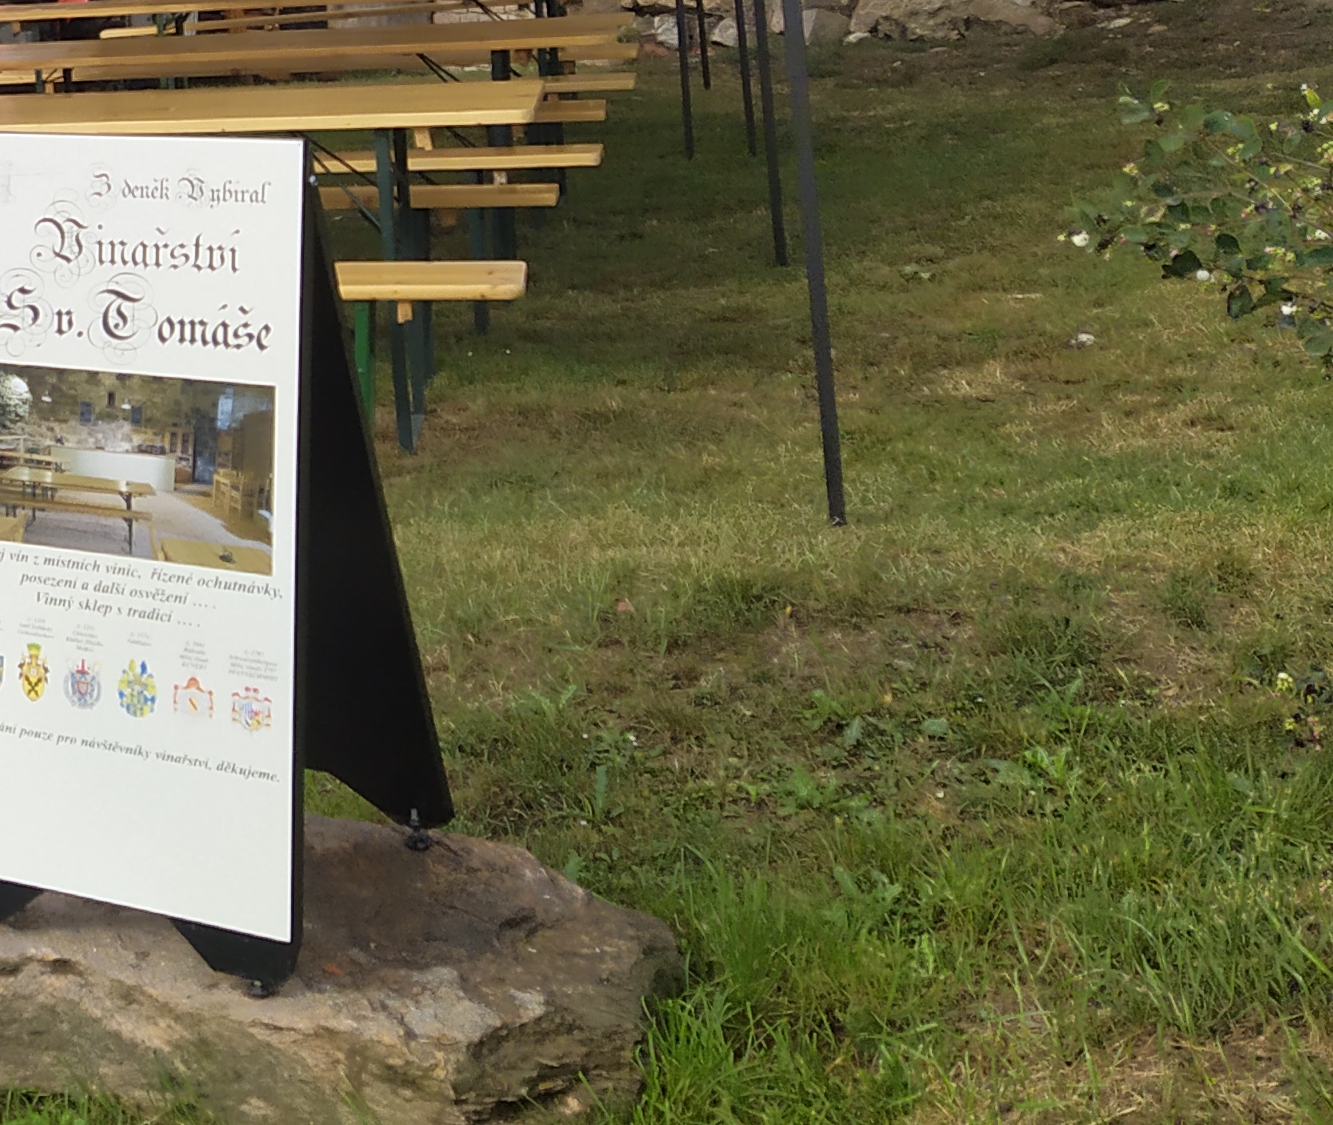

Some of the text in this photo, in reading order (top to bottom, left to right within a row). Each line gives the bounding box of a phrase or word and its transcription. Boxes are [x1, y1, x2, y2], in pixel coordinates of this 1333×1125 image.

[32, 211, 241, 276] Vinařství
[91, 279, 273, 352] Tomáše
[9, 549, 30, 563] vín
[34, 555, 40, 566] z
[43, 554, 101, 573] místních
[150, 567, 194, 586] řízené
[19, 573, 79, 590] posezení
[81, 582, 89, 591] a
[93, 580, 126, 596] další
[129, 587, 190, 605] osvěžení
[35, 591, 75, 611] Vinný
[78, 598, 113, 617] sklep
[117, 607, 123, 616] s
[127, 605, 173, 623] tradicí
[19, 727, 53, 743] pouze
[56, 733, 77, 747] pro
[80, 735, 152, 761] návštěvníky
